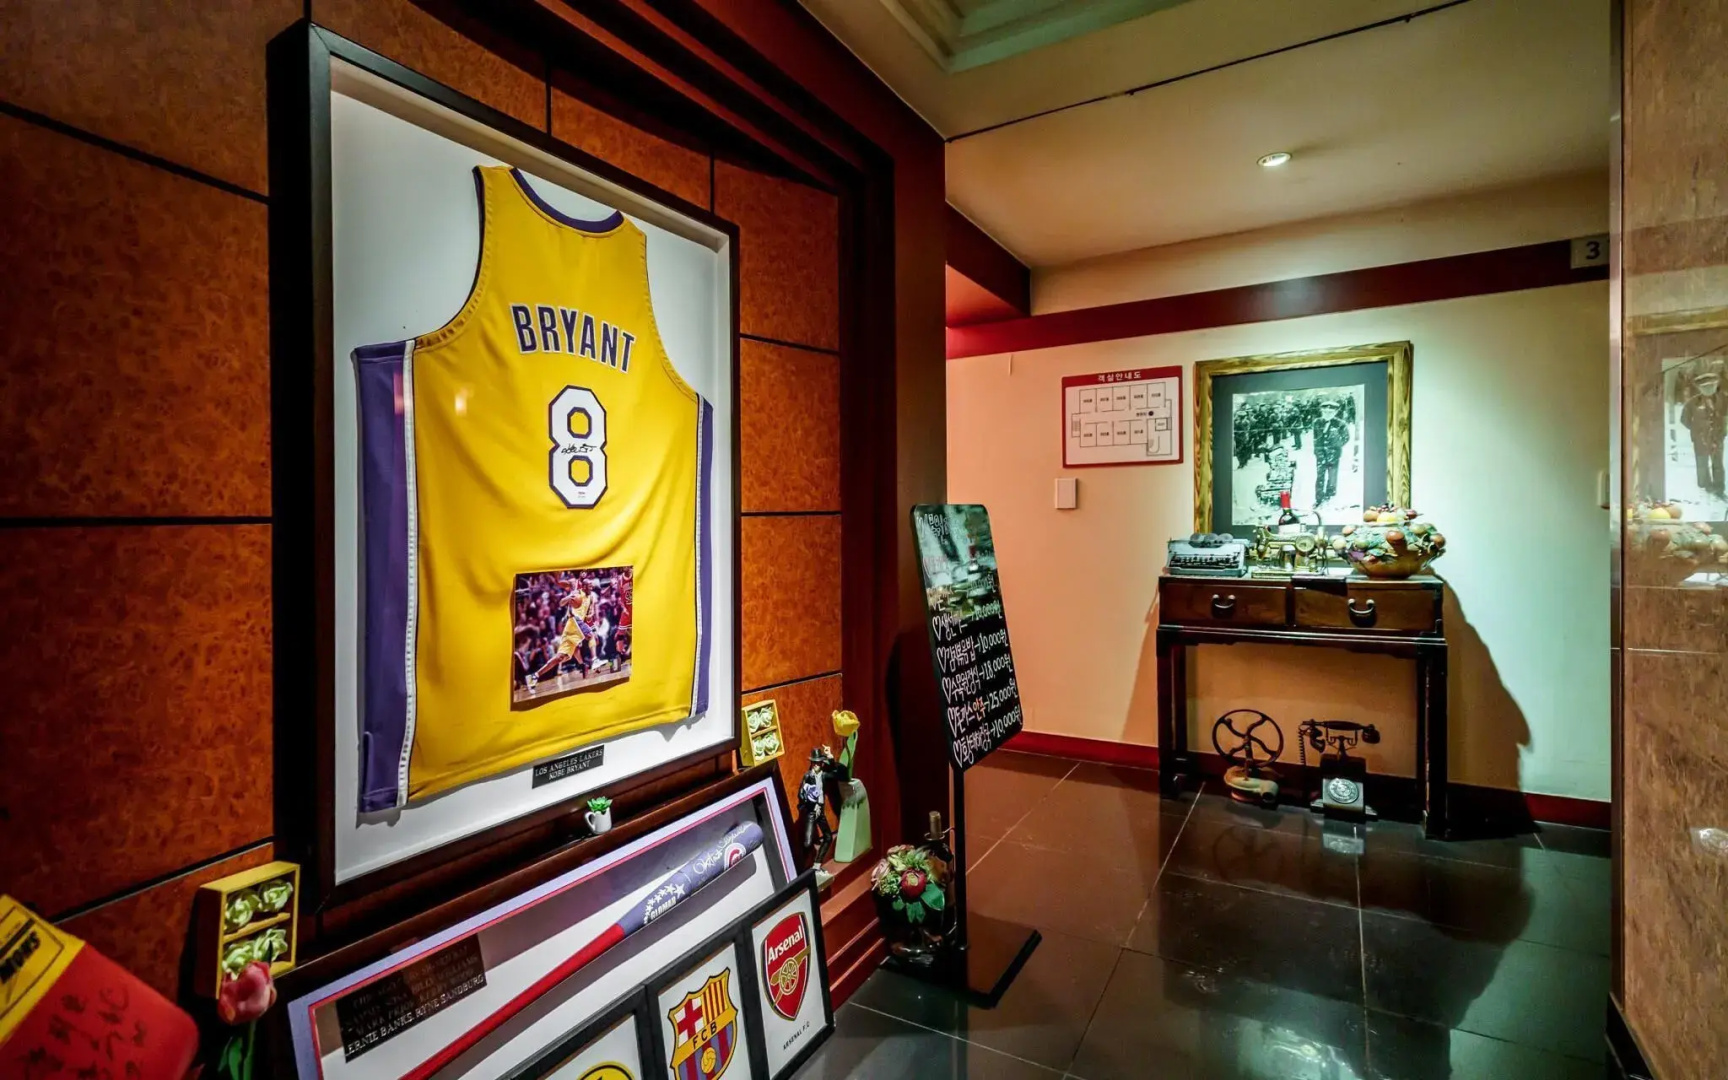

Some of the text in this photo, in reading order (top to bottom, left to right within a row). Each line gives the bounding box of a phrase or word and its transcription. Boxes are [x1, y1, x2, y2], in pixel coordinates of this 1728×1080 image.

[1585, 241, 1601, 260] 3
[510, 302, 636, 374] BRYANT
[1098, 371, 1142, 382] 객실안내도
[548, 384, 608, 510] 8
[535, 749, 603, 777] LOS ANGELES LAKERS
[548, 760, 590, 780] KOBE BRYANT
[768, 925, 804, 966] Arsenal
[347, 1030, 379, 1054] ERNIE
[415, 998, 440, 1018] RYNE
[783, 1029, 802, 1050] ARSENAL
